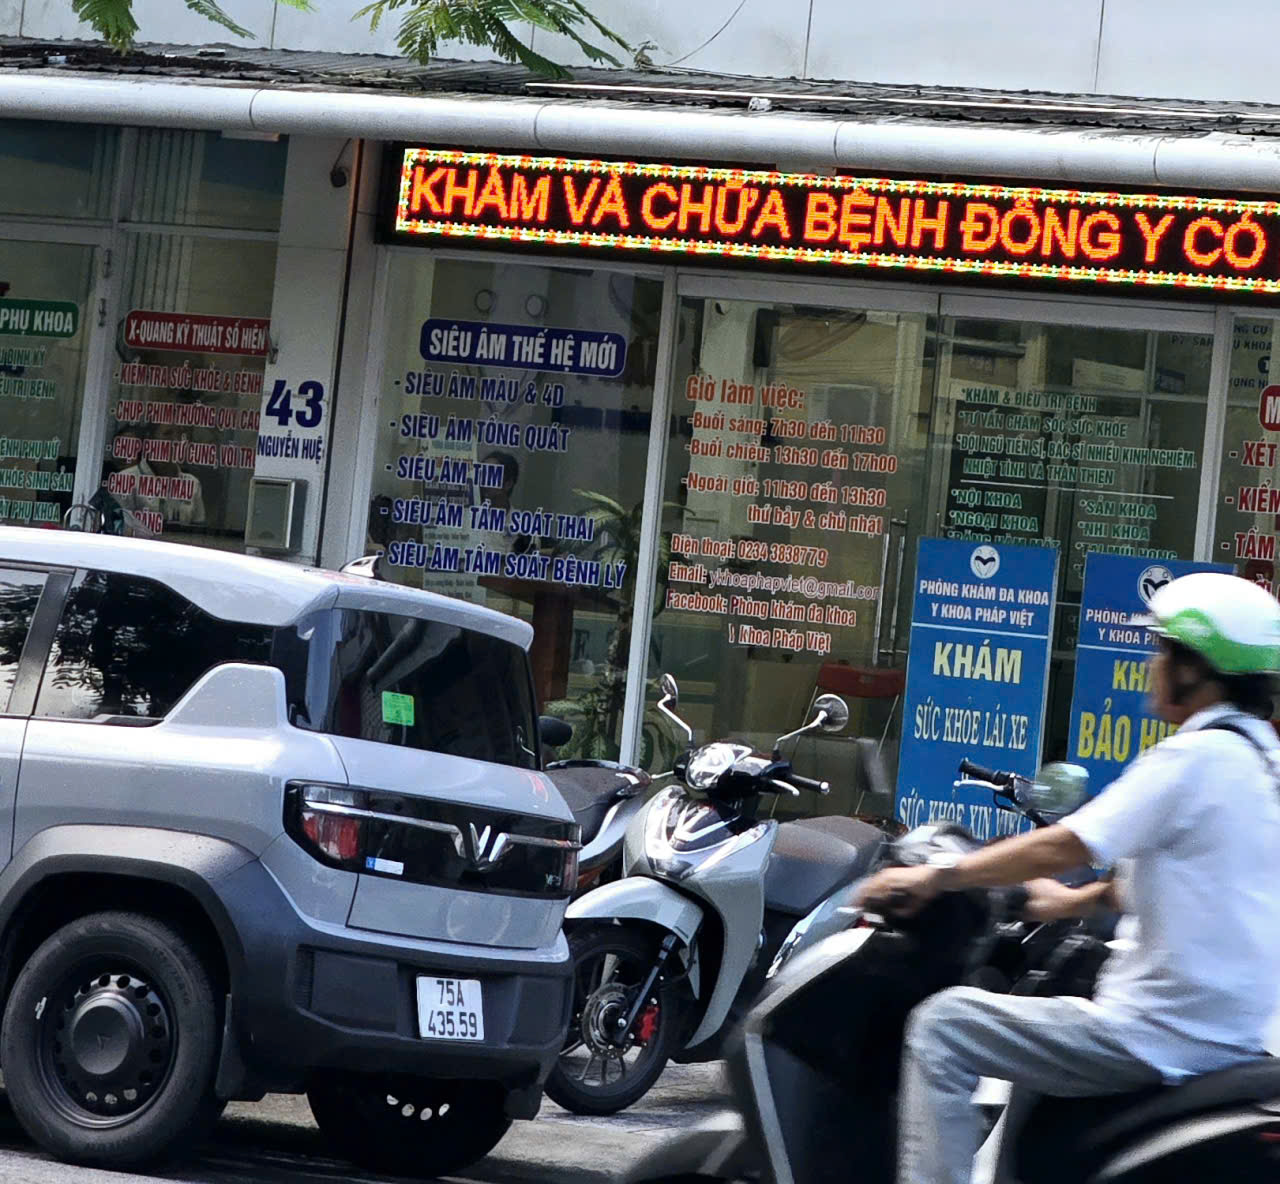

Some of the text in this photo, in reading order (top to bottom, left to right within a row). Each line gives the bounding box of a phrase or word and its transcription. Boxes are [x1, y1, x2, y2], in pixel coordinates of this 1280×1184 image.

[804, 187, 949, 251] BỆNH
[1135, 212, 1175, 263] Y
[1183, 211, 1267, 270] CÓ
[35, 310, 73, 333] KHOA
[129, 319, 173, 348] X-QUANG
[430, 325, 617, 371] SIÊU ÂM THẾ HỆ MỚI
[266, 379, 324, 427] 43
[525, 380, 565, 407] & 4D
[686, 375, 716, 402] Giờ
[721, 379, 755, 405] làm
[770, 418, 805, 437] 7h30
[841, 424, 885, 445] 11h30
[301, 434, 323, 468] HUỆ
[774, 445, 818, 465] 13h30
[853, 452, 897, 473] 17h00
[1243, 439, 1277, 466] XÉT
[473, 463, 504, 488] TIM
[763, 479, 807, 501] 11h30
[842, 487, 886, 507] 13h30
[557, 514, 594, 542] THAI
[803, 510, 815, 529] &
[738, 541, 768, 562] 0234
[770, 543, 827, 567] 3838779
[669, 563, 708, 586] Email:
[920, 576, 1049, 606] PHÒNG KHÁM ĐA KHOA
[666, 588, 728, 614] Facebook:
[827, 604, 856, 627] khoa
[932, 602, 1035, 628] Y KHOA PHÁP VIỆT
[1099, 628, 1140, 643] Y KHOA
[933, 639, 1022, 684] KHÁM
[1008, 717, 1028, 750] XE
[1078, 697, 1130, 762] BẢO
[436, 980, 464, 1007] 75A
[428, 1011, 477, 1037] 435.59
